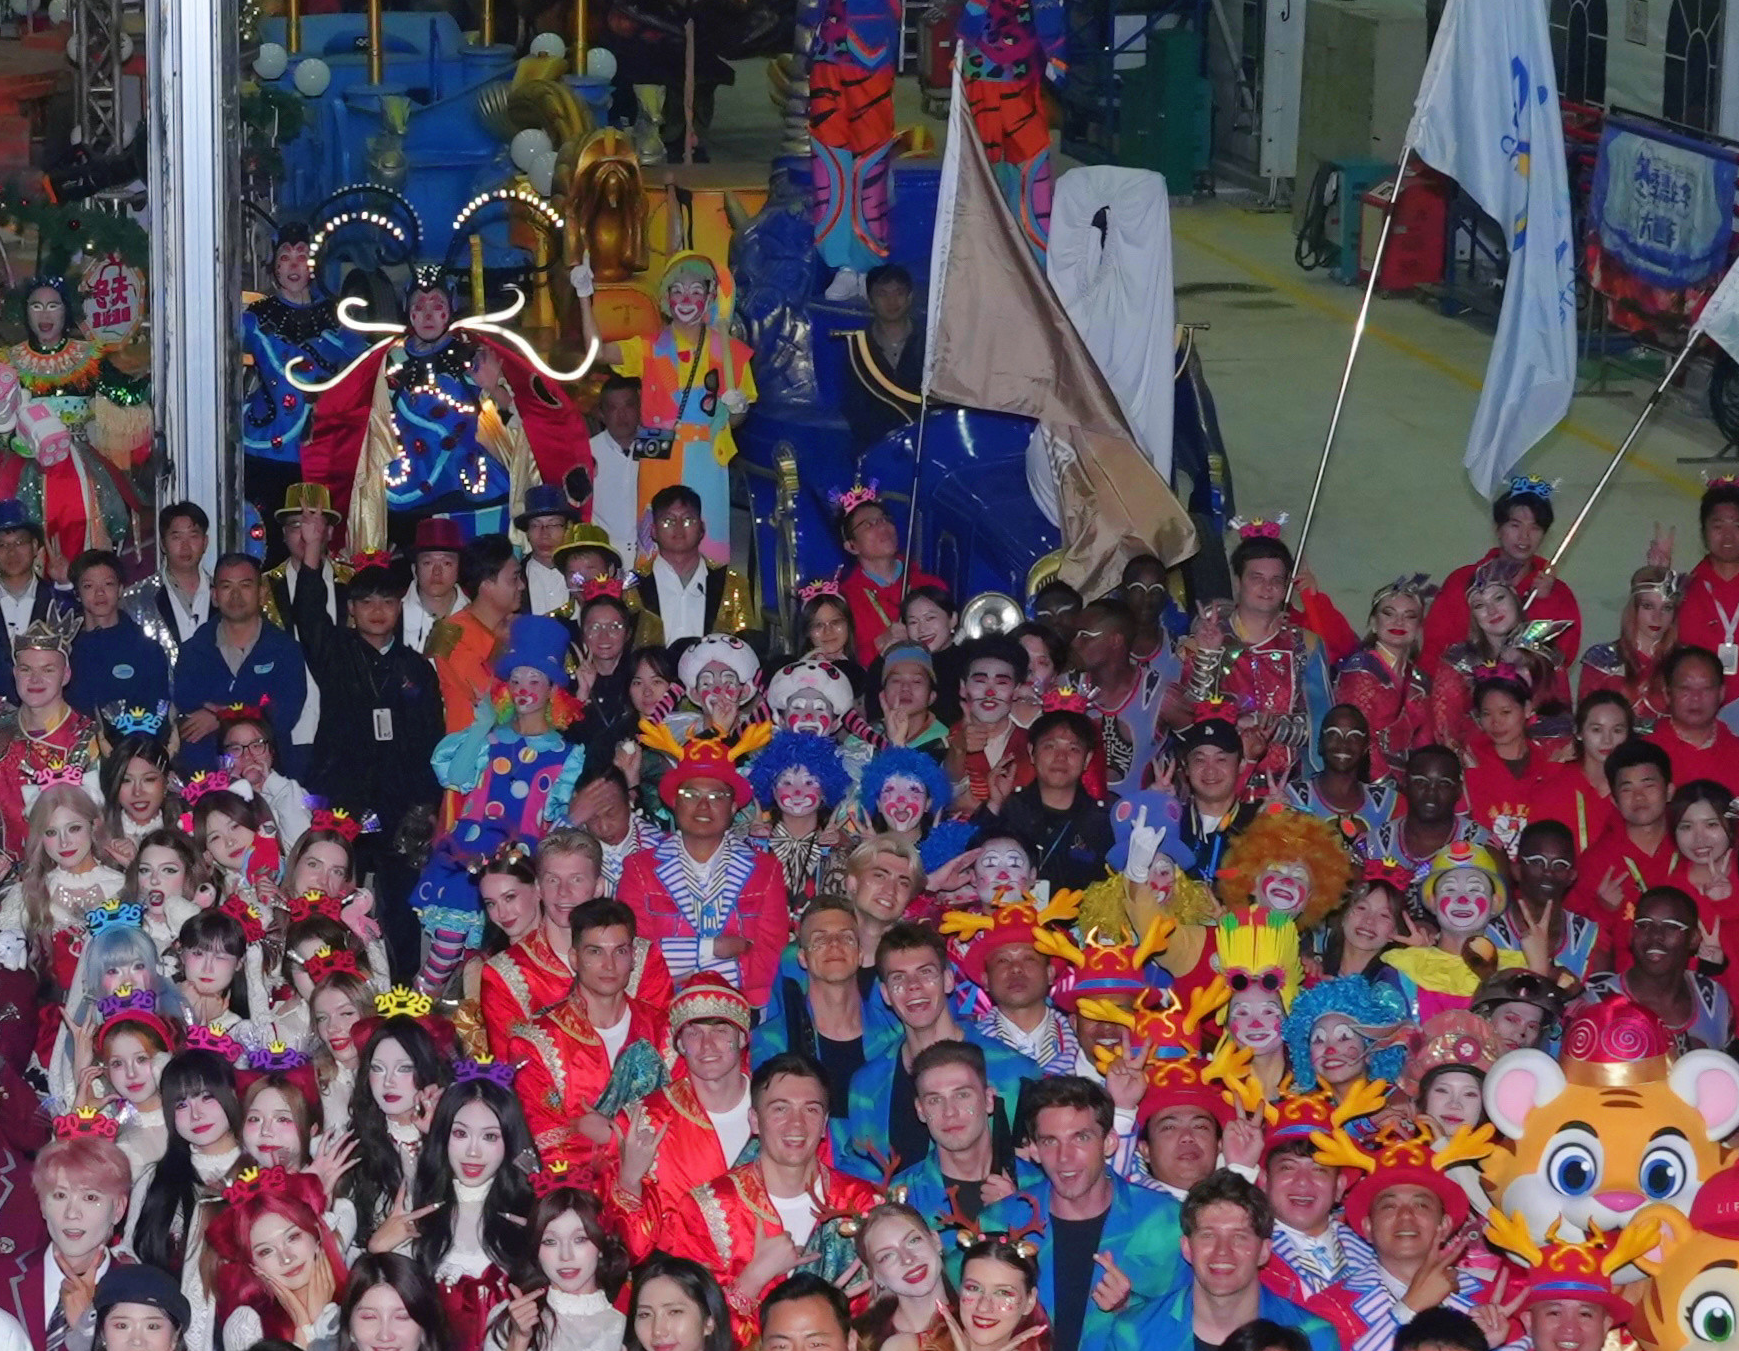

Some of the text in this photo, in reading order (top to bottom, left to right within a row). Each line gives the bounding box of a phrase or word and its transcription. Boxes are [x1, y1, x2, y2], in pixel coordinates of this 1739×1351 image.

[113, 711, 164, 730] 2026
[32, 764, 83, 783] 2026
[86, 902, 142, 927] 2026
[375, 991, 432, 1013] 2026
